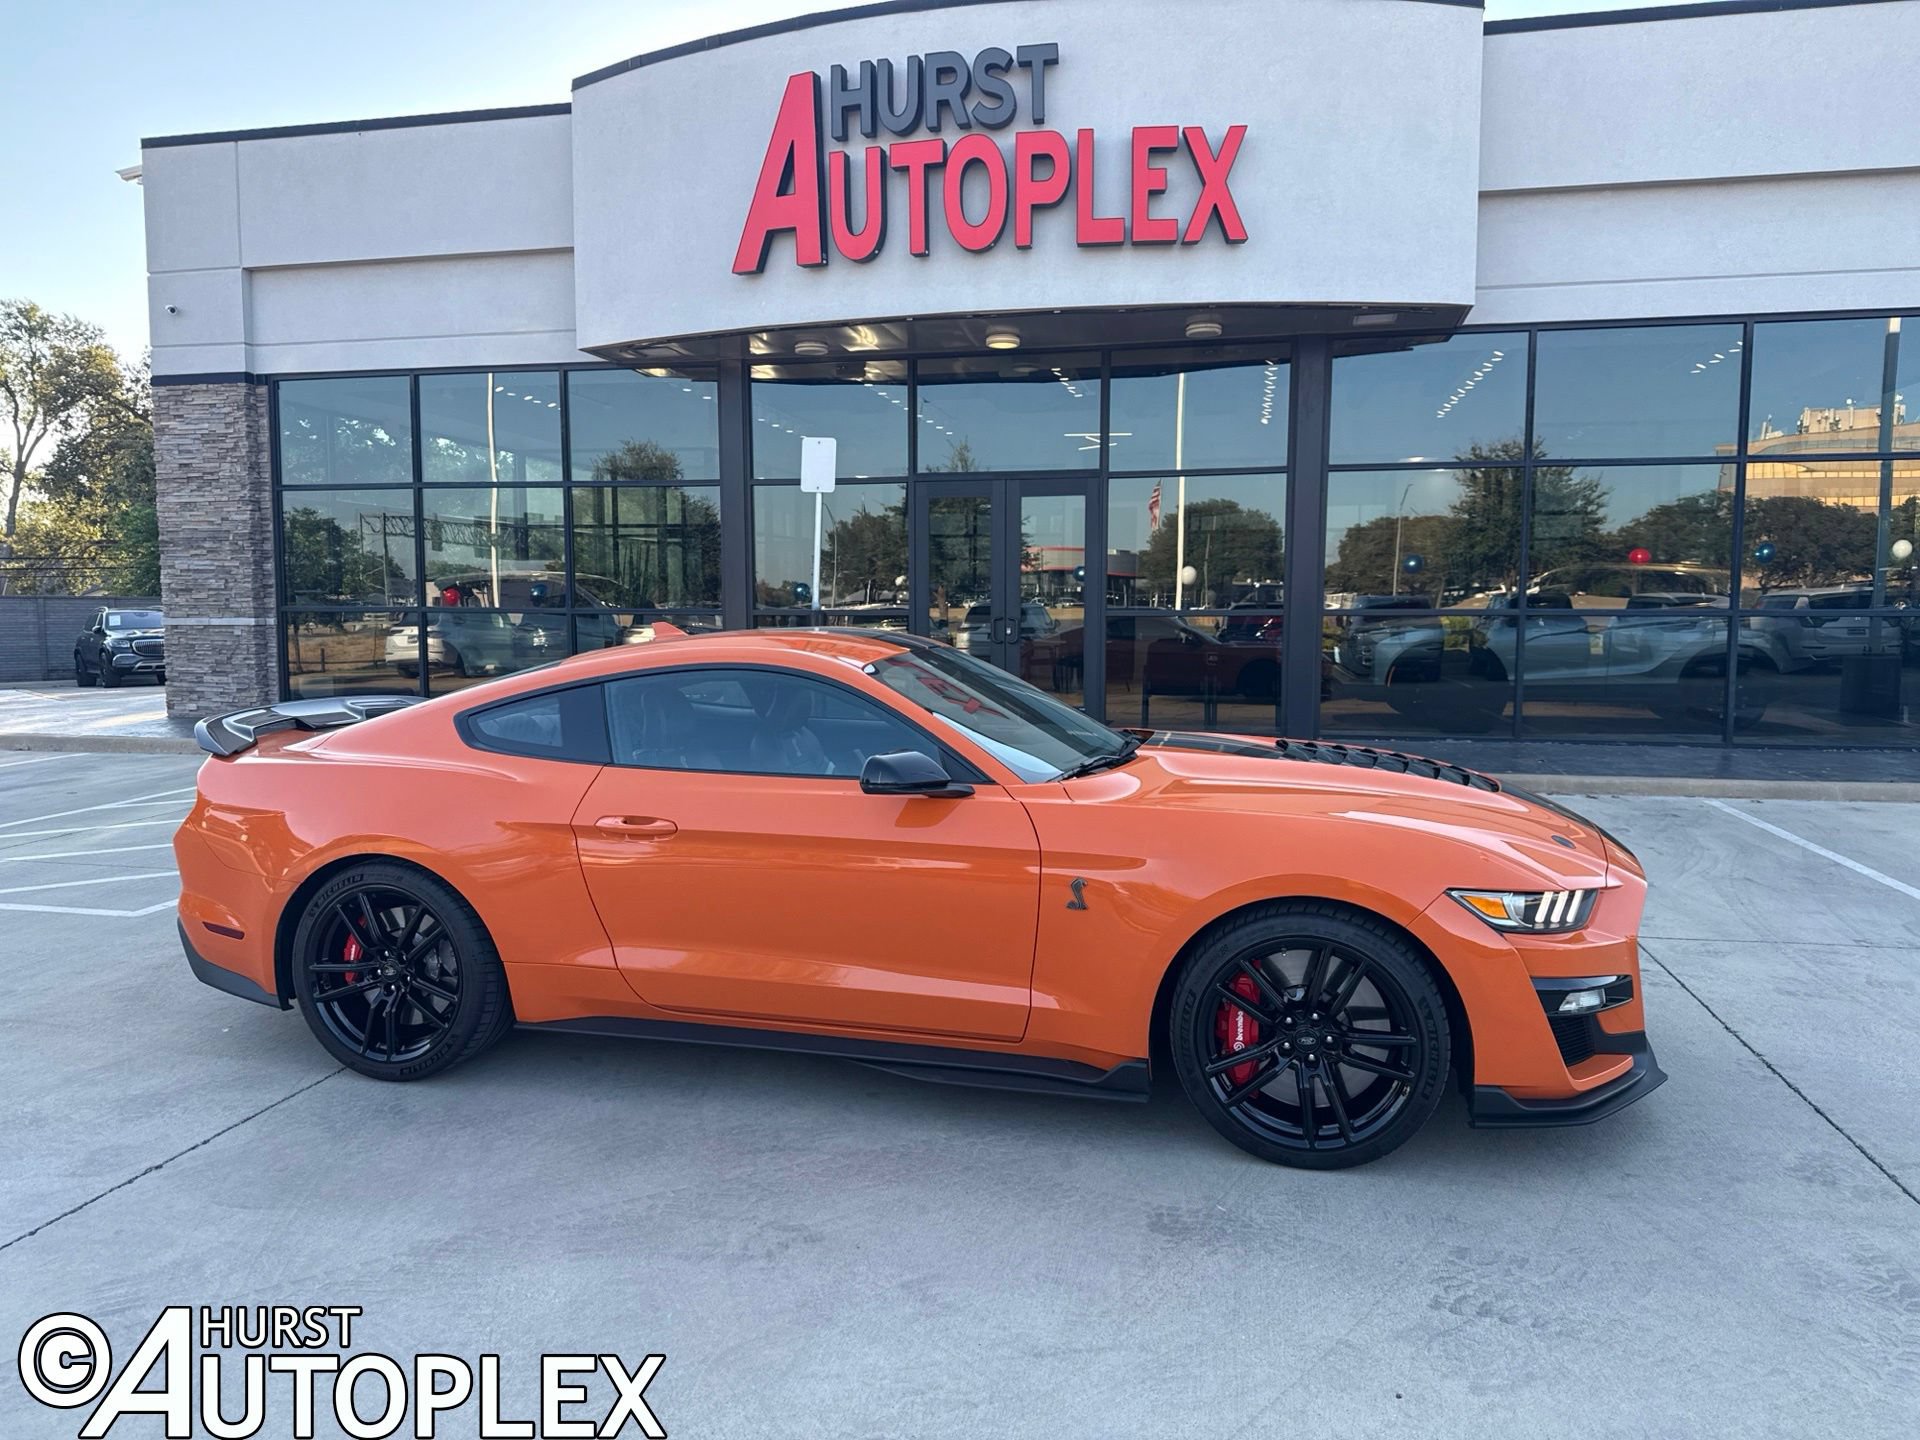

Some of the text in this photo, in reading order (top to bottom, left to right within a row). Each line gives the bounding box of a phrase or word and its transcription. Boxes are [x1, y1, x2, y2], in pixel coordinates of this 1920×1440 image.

[830, 43, 1059, 142] HURST
[732, 70, 1248, 275] AUTOPLEX
[1235, 1010, 1244, 1041] brembo
